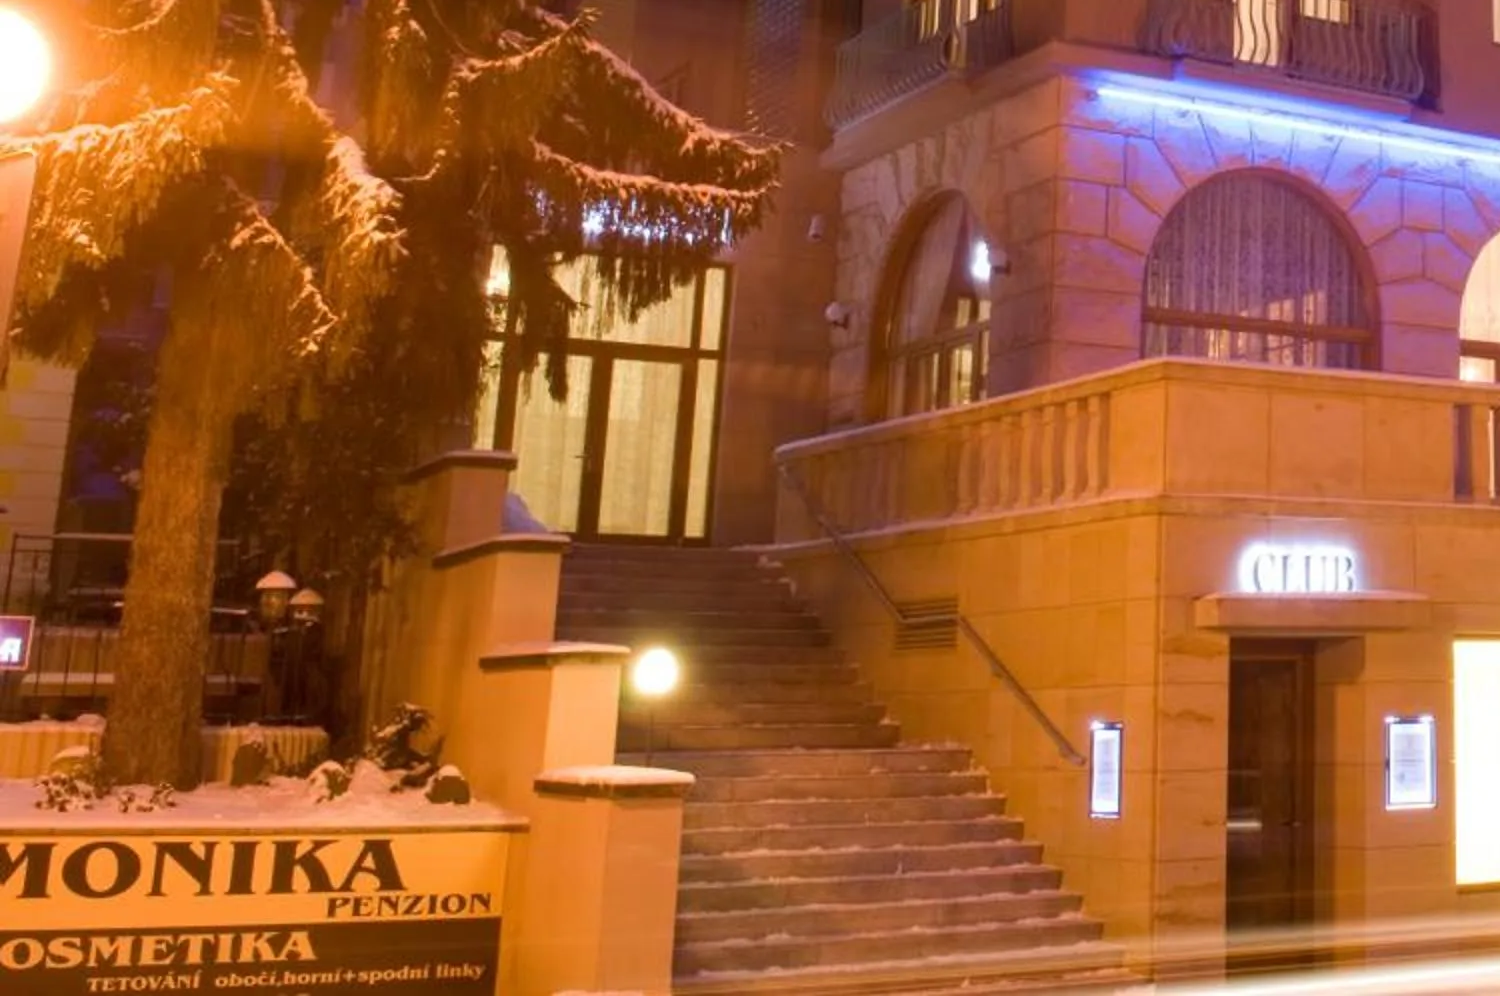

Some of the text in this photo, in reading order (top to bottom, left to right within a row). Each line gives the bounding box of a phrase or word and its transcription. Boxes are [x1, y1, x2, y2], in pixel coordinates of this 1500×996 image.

[1251, 552, 1355, 592] CLUB
[0, 839, 407, 899] MONIKA
[326, 893, 493, 918] PENZION
[87, 970, 202, 992] TETOVÁNÍ
